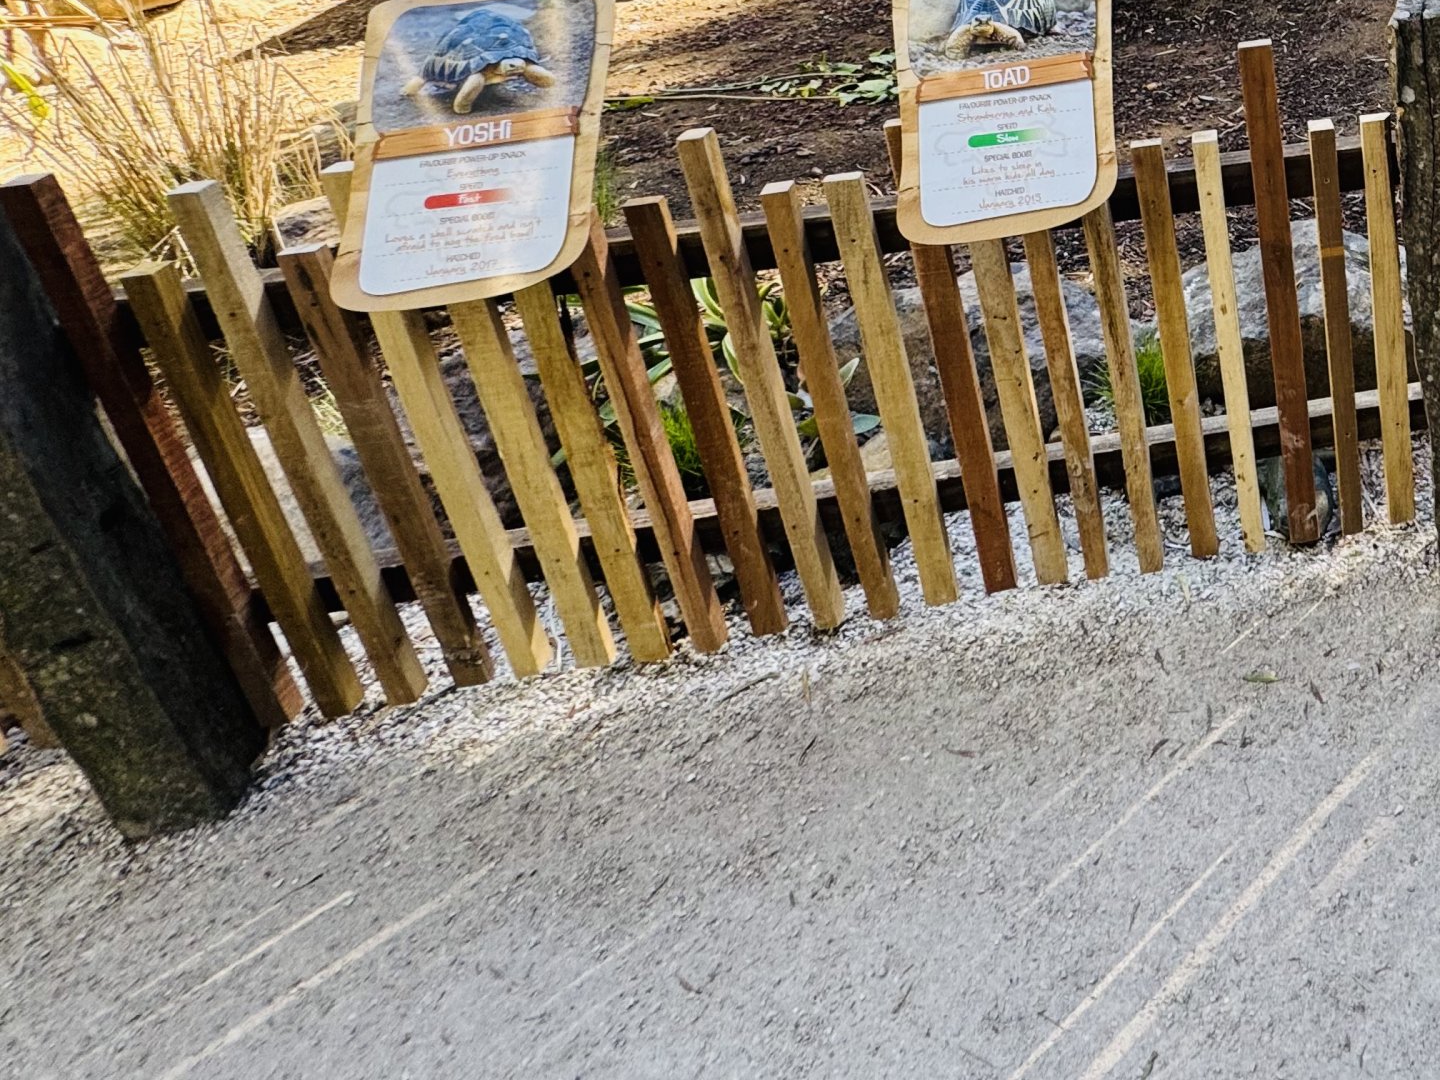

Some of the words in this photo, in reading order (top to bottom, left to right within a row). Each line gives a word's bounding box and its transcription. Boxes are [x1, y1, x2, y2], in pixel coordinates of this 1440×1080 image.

[980, 66, 1030, 90] TOAD
[1029, 94, 1052, 102] SNACK
[996, 133, 1018, 143] Slow
[984, 153, 1010, 162] SPECIAL
[999, 163, 1007, 171] to
[995, 187, 1025, 197] HATCHED
[458, 194, 482, 203] Fast
